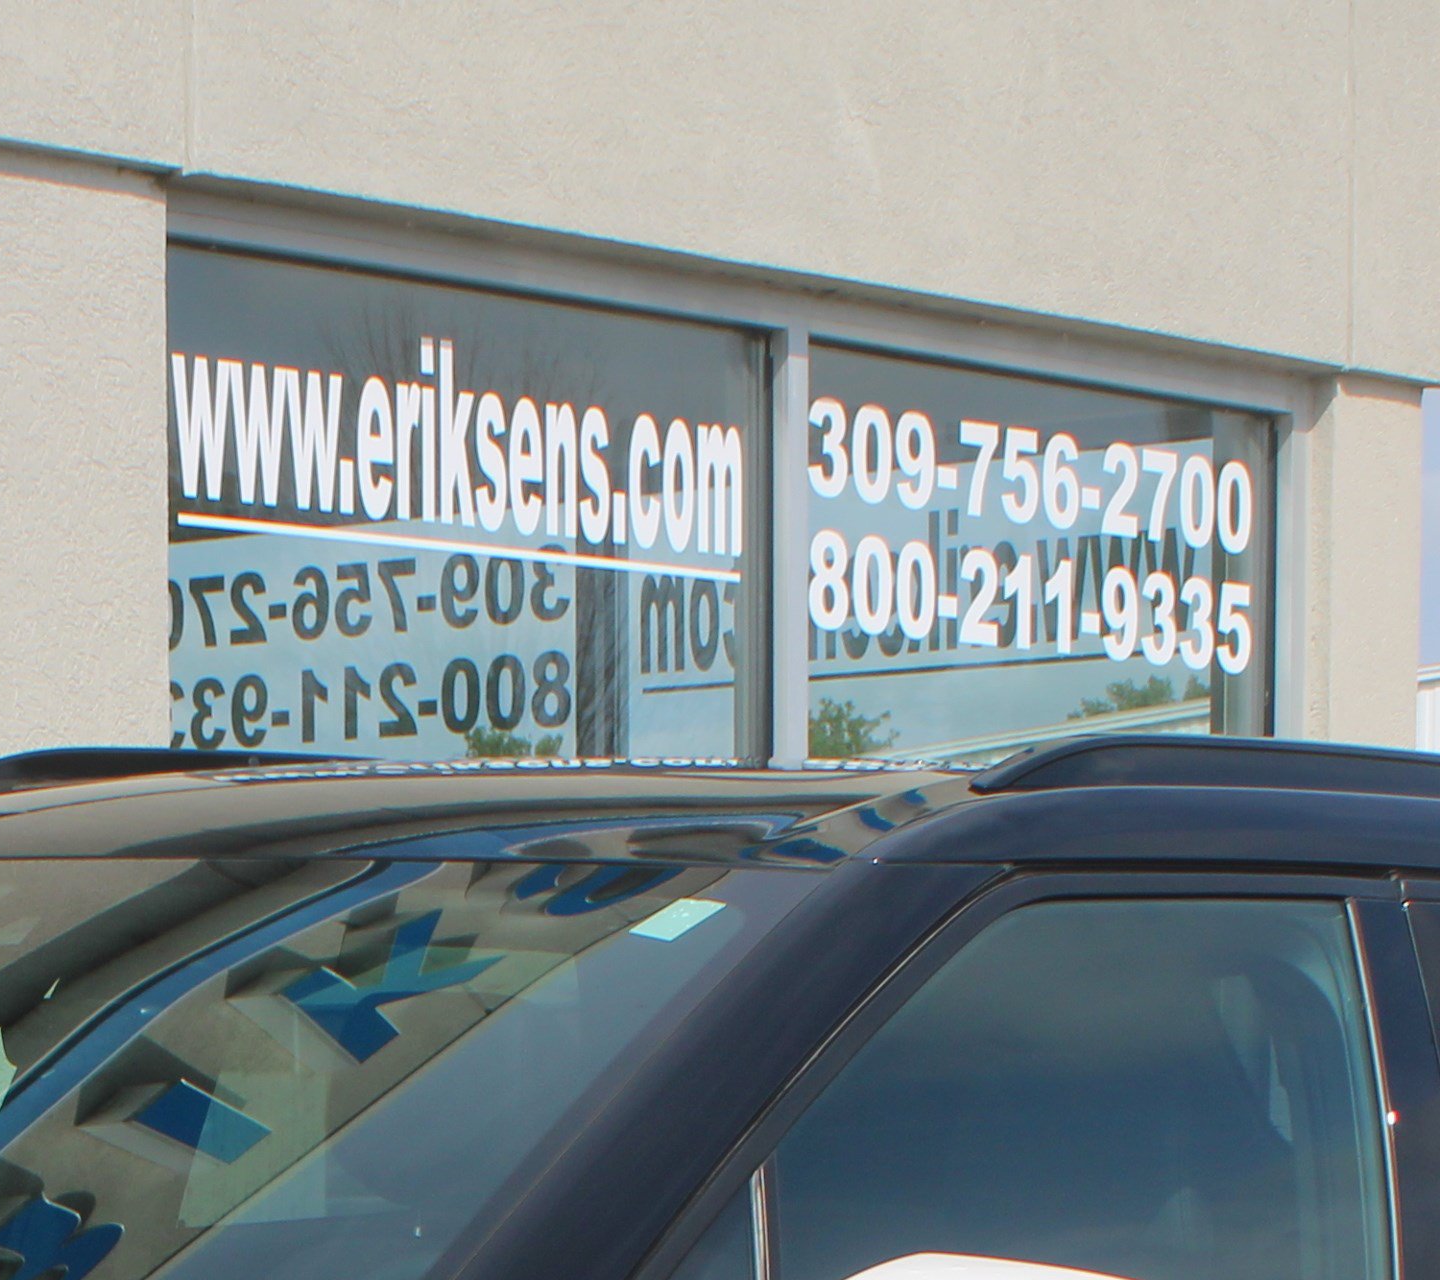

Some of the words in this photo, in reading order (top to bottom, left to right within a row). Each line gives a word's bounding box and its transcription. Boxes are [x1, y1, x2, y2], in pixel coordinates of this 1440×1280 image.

[172, 337, 743, 557] www.eriksens.com
[808, 398, 1253, 555] 309-756-2700
[809, 530, 1253, 675] 800-211-9335
